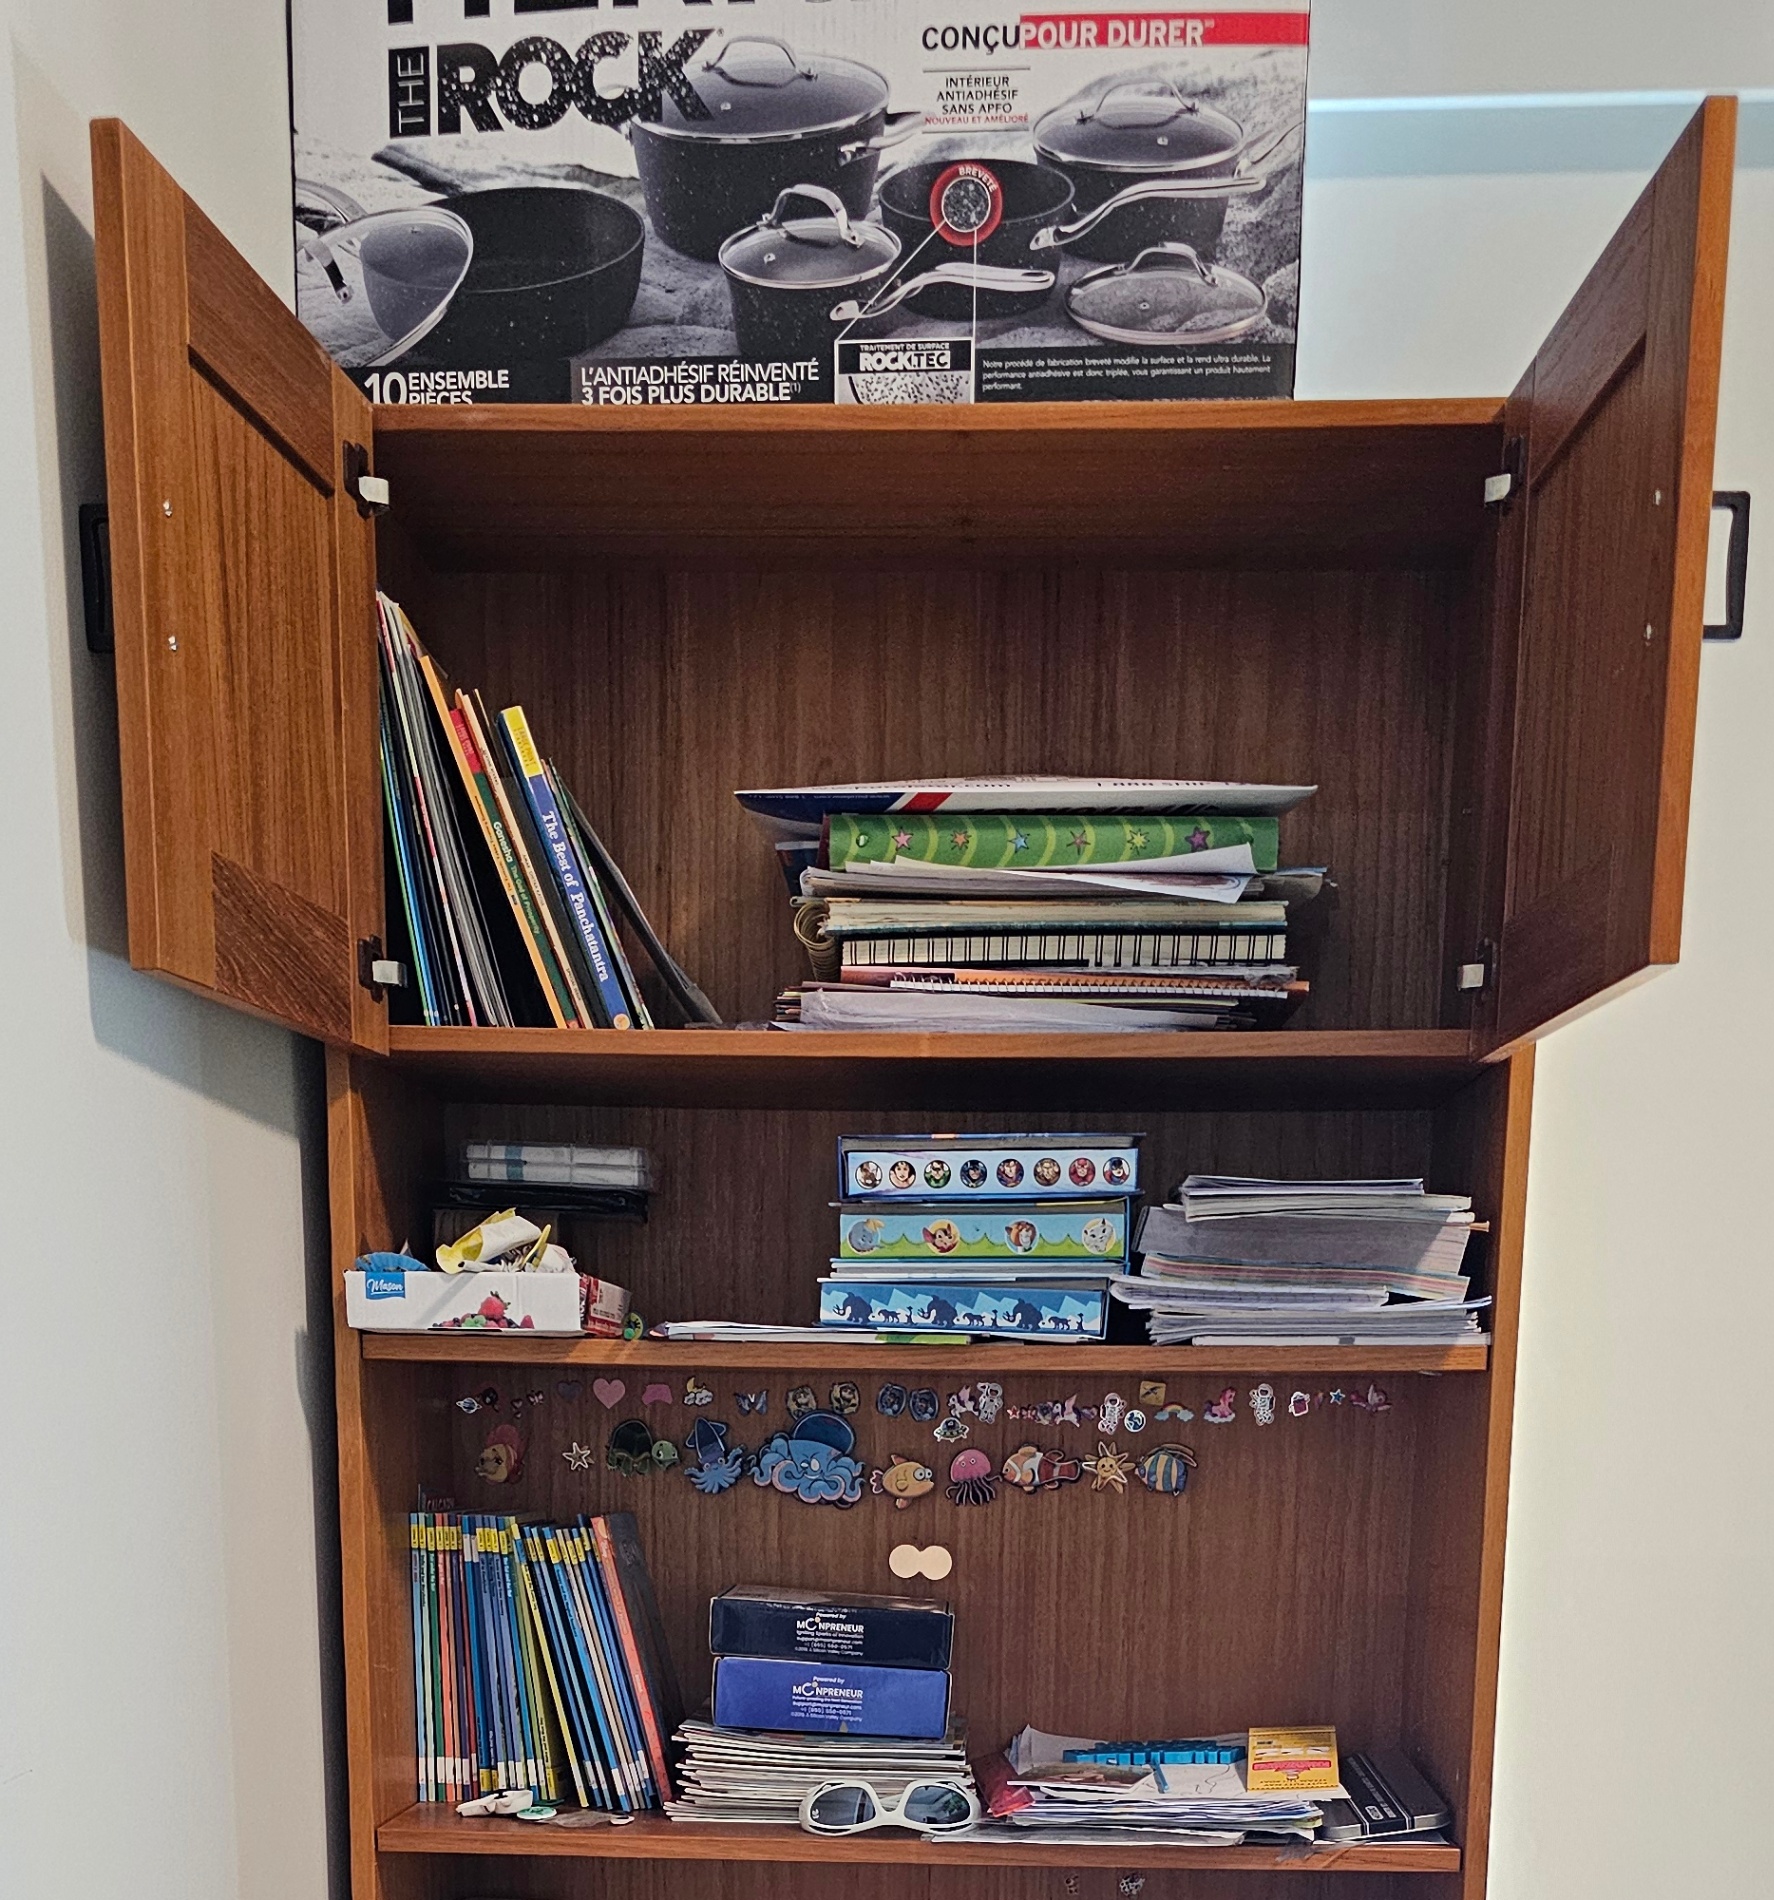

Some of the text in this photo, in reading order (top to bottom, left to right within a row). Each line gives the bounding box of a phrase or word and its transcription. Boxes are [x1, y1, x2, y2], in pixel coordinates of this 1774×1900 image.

[922, 20, 1203, 55] CONÇU POUR DURER
[437, 28, 716, 136] ROCK
[946, 75, 1009, 88] INTÉRIEUR
[396, 52, 426, 134] THE
[937, 88, 1018, 101] ANTIADHÉSIF
[925, 116, 968, 124] NOUVEAU
[984, 113, 1028, 123] AMÉLIORÉ
[942, 102, 1012, 115] SANS APFO
[860, 344, 904, 352] TRAITEMENT
[581, 358, 819, 386] L'ANTIADHÉSIF RÉINVENTÉ
[1035, 359, 1045, 367] de
[364, 370, 510, 404] 10 ENSEMBLE
[581, 387, 593, 405] 3
[599, 386, 642, 405] FOIS
[649, 384, 695, 404] PLUS
[493, 820, 540, 935] Ganesha The God of Prosperity
[542, 810, 609, 982] The Best of Panchatantra
[366, 1279, 404, 1294] Mason
